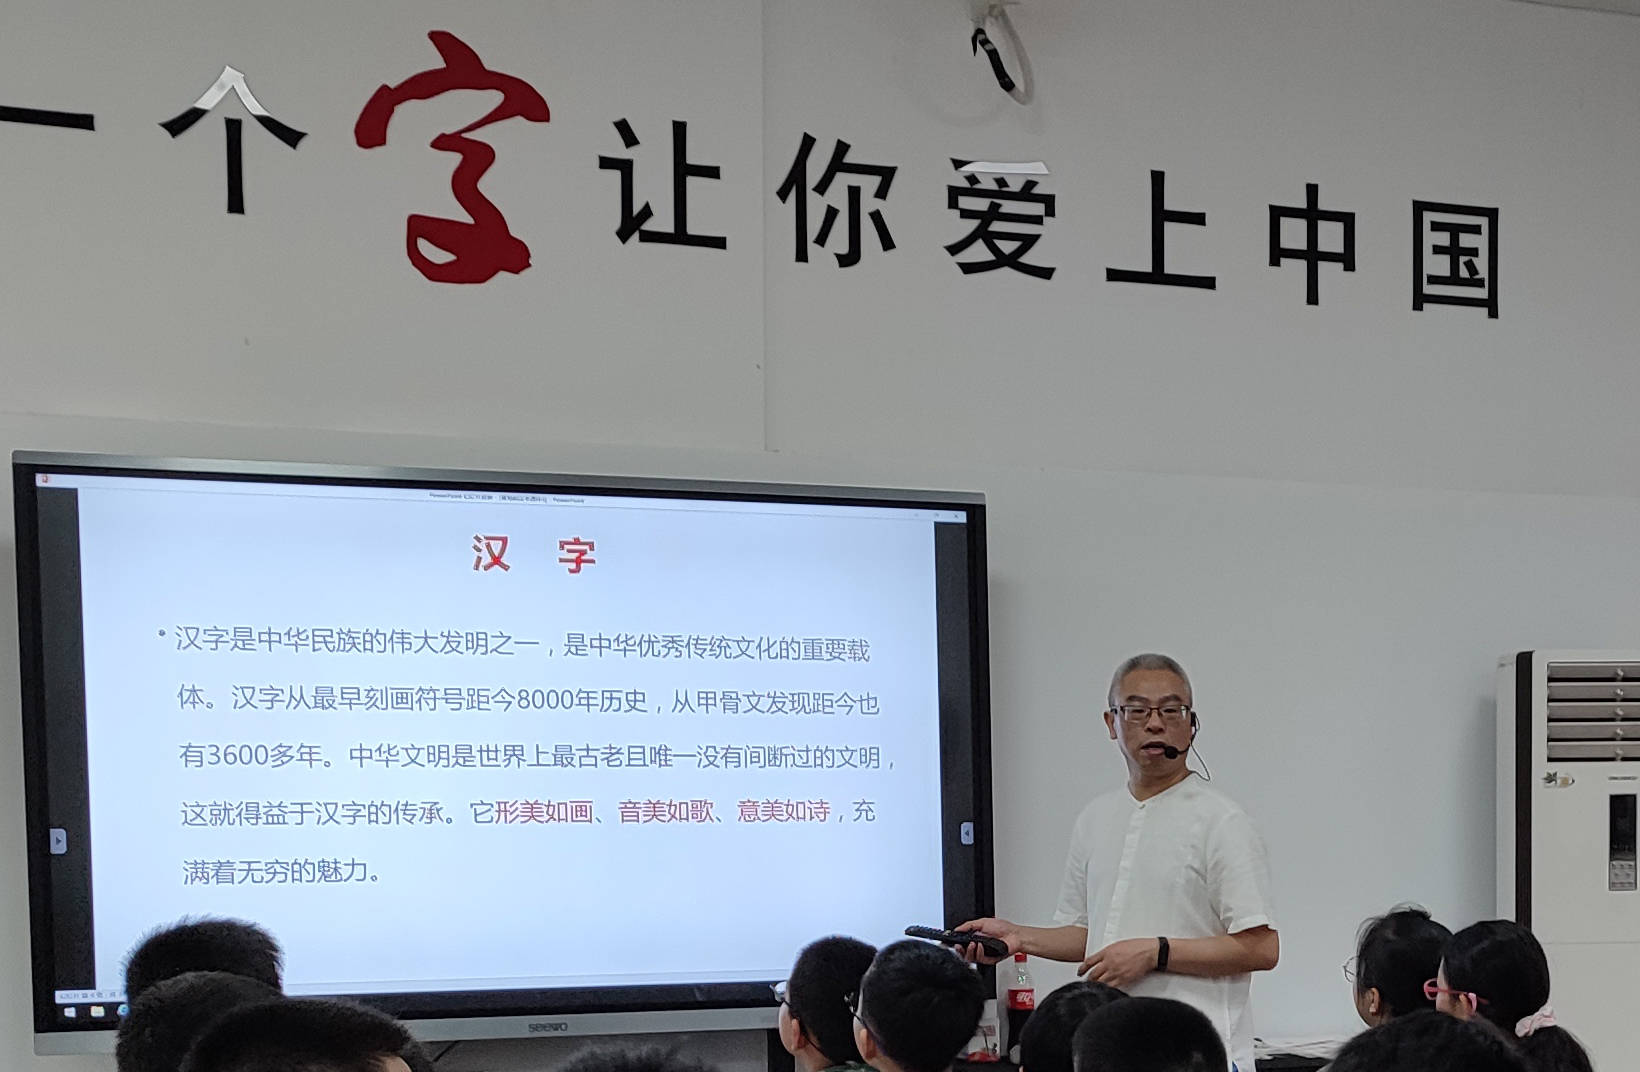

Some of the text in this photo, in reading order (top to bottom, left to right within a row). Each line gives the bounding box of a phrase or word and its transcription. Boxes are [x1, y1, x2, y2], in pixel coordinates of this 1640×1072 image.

[0, 30, 1499, 319] 一个字让你爱上中国
[183, 857, 380, 886] 满着无穷的魅力。
